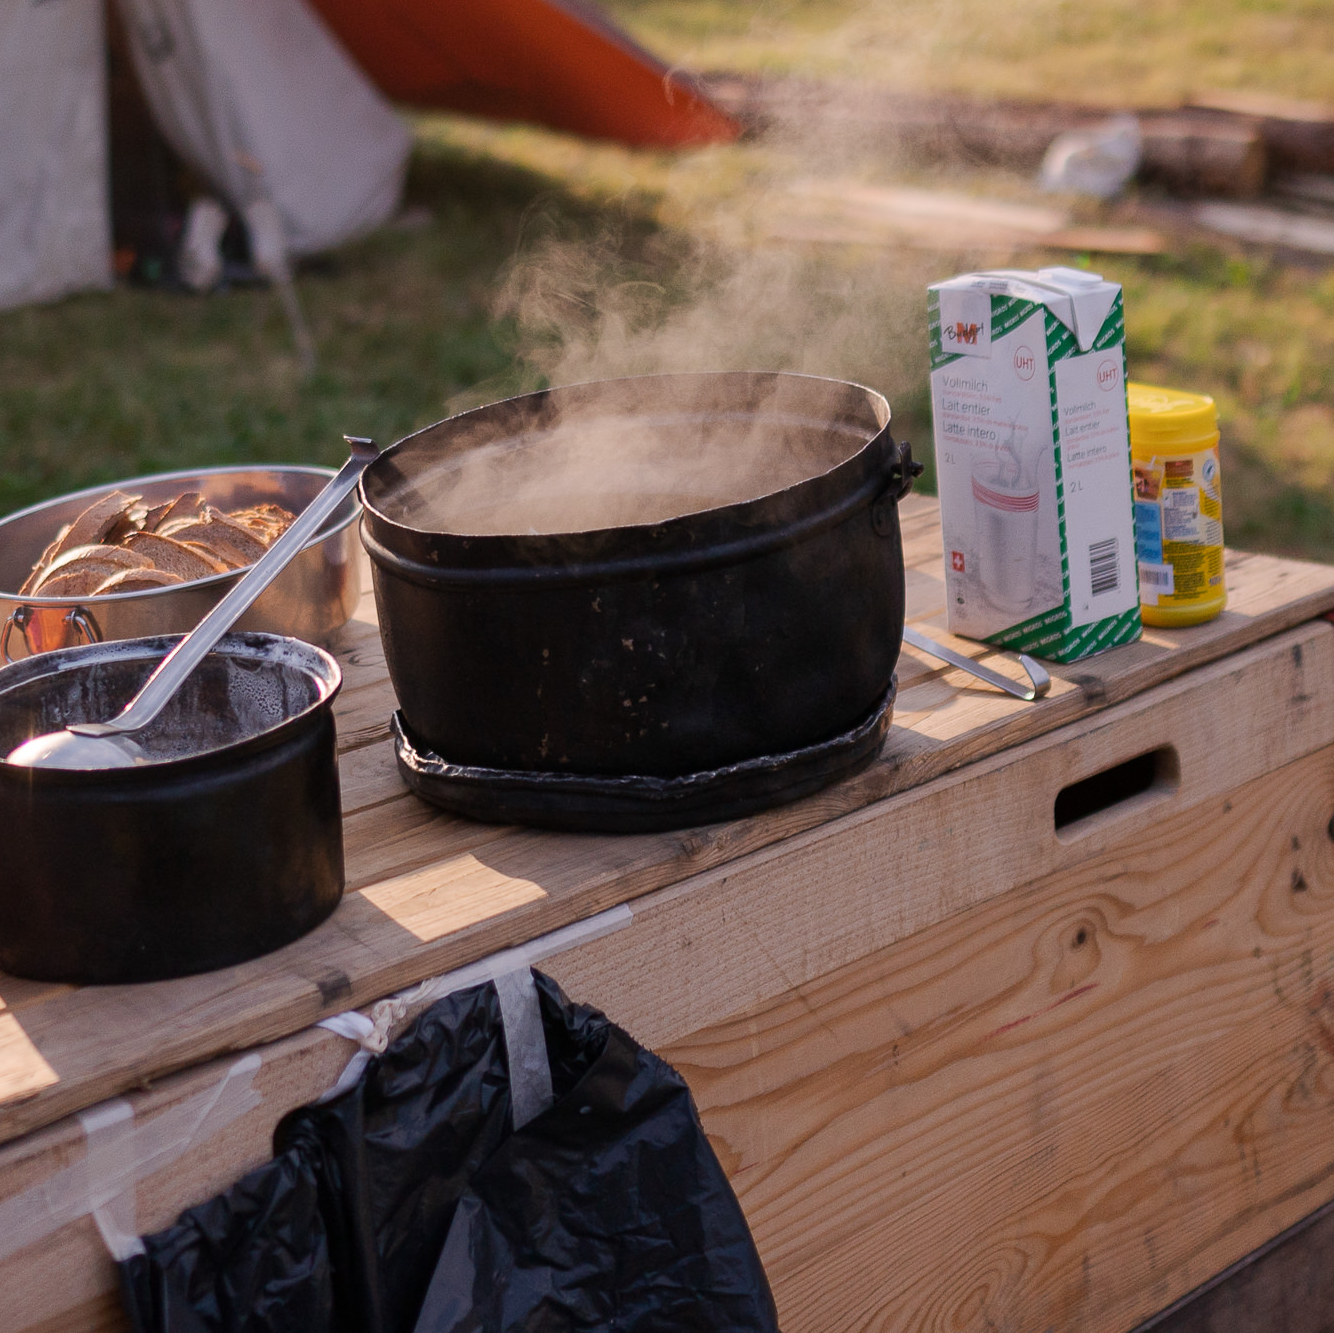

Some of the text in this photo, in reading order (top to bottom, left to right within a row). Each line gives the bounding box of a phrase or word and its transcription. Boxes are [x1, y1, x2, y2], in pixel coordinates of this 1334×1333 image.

[1017, 356, 1034, 370] UHT
[943, 375, 988, 392] Vollmilch
[1099, 368, 1117, 383] UHT
[942, 398, 990, 416] Lait entier
[1064, 401, 1096, 416] Vollmilch
[943, 420, 965, 435] Latte
[967, 425, 996, 441] intero
[1065, 425, 1079, 437] Lait
[1067, 451, 1085, 463] Latte
[1023, 621, 1043, 634] MIGROS
[1044, 610, 1067, 624] MIGROS
[1098, 619, 1118, 641] MIGROS
[1040, 632, 1062, 645] MIGROS
[1058, 638, 1081, 656] MIGROS
